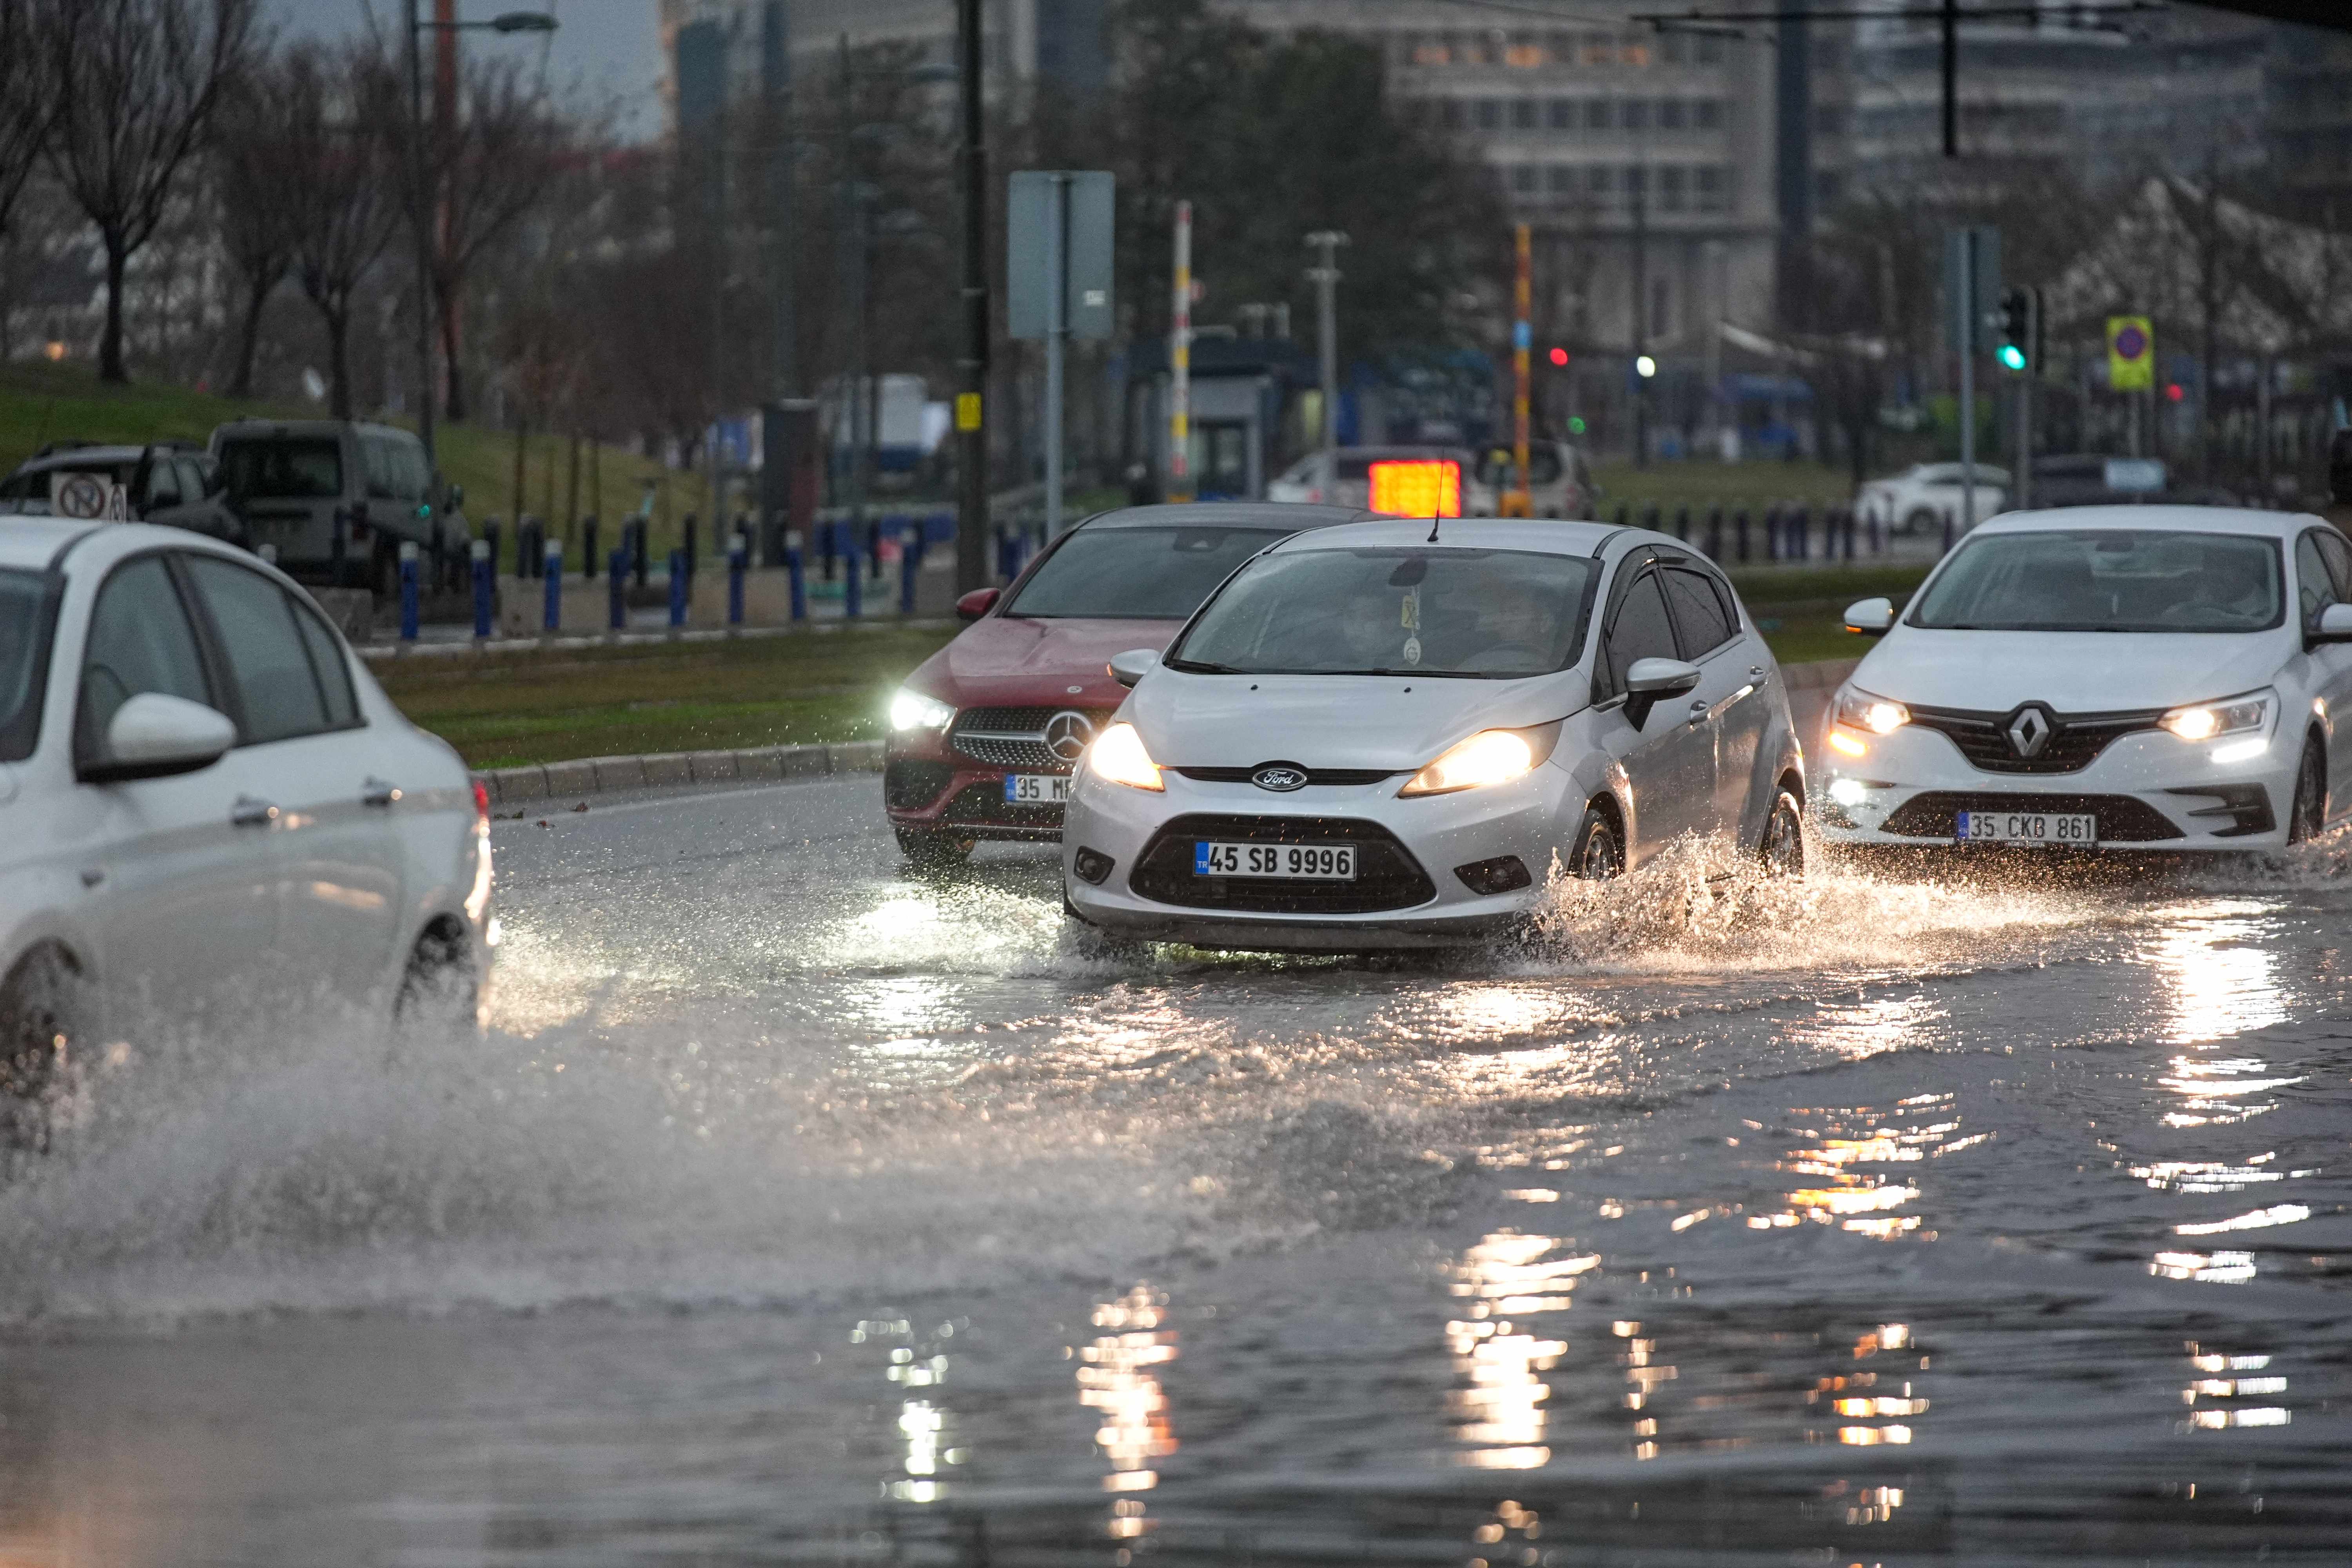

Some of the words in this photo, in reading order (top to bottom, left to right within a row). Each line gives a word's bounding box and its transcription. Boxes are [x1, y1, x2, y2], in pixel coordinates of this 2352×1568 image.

[1018, 778, 1040, 798] 35
[1263, 771, 1294, 783] Ford
[1971, 815, 1994, 837] 35
[2008, 816, 2045, 838] CKB
[2058, 817, 2091, 839] 861
[1210, 846, 1238, 871] 45
[1249, 848, 1278, 873] SB
[1289, 849, 1350, 875] 9996
